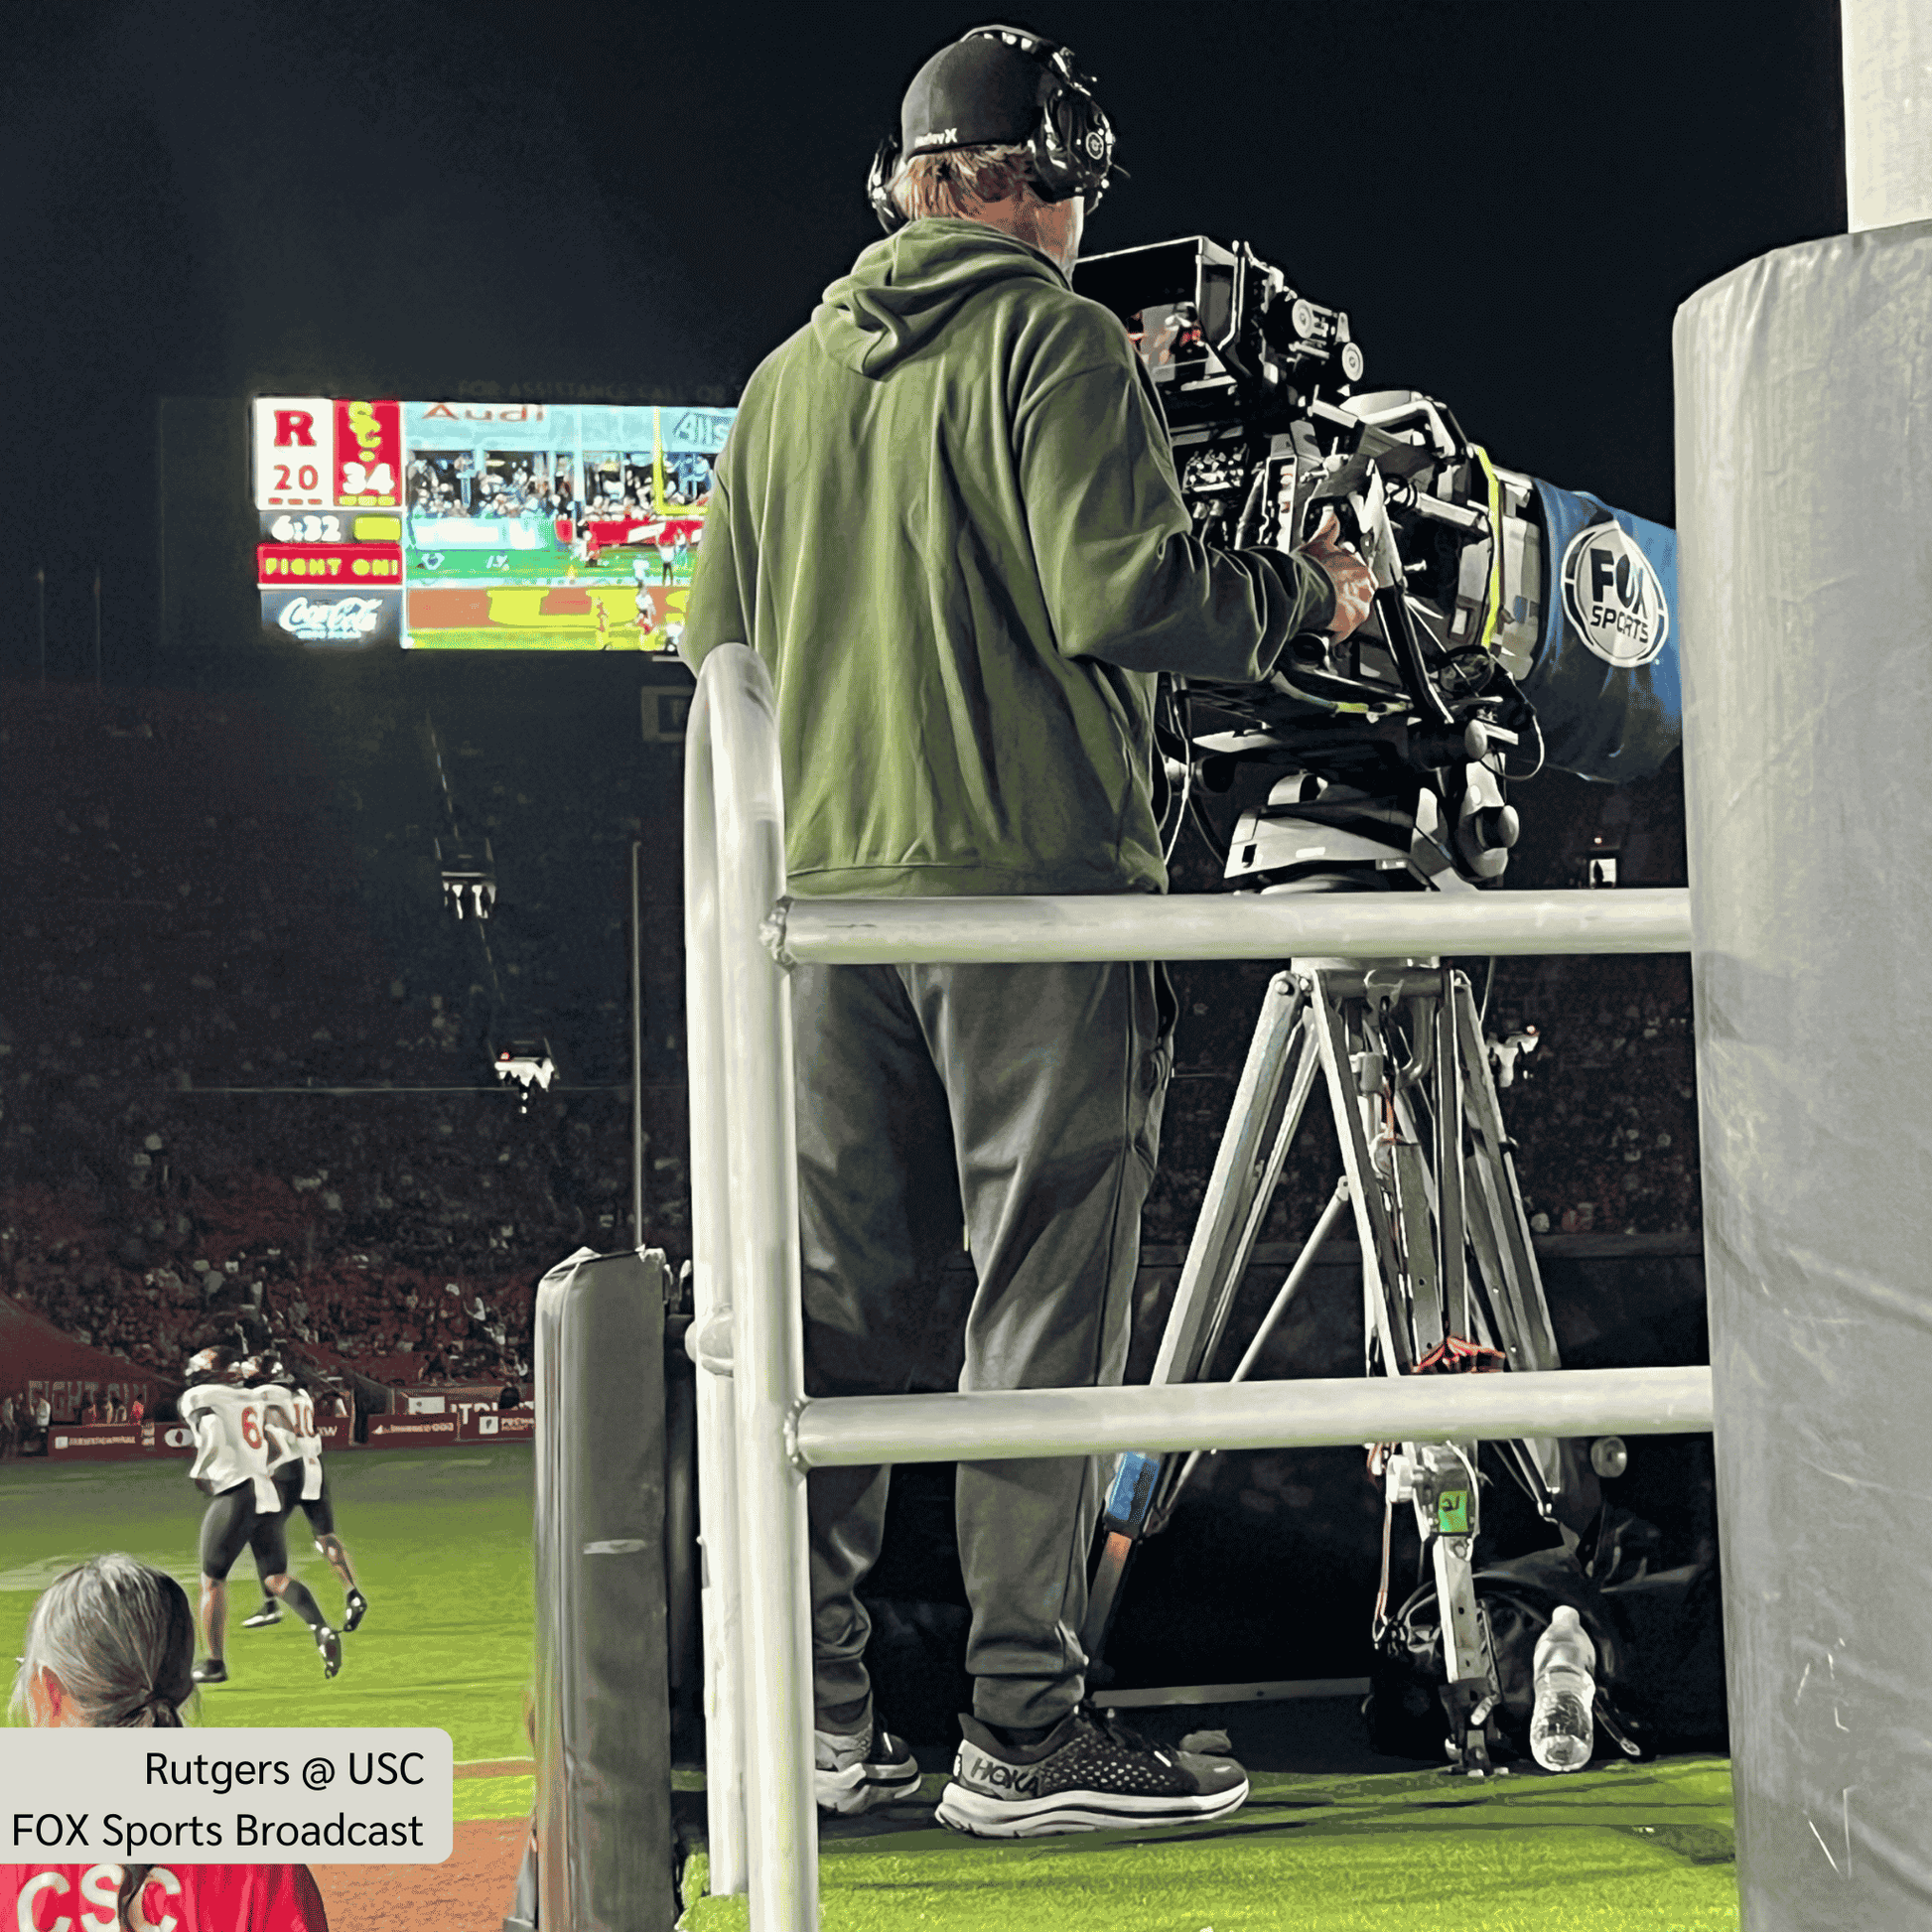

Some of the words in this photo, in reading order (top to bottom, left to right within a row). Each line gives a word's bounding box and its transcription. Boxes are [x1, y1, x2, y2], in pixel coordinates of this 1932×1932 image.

[273, 409, 317, 447] R
[273, 465, 319, 490] 20
[342, 462, 395, 495] 34
[1589, 605, 1649, 644] SPORTS
[241, 1406, 262, 1449] 6
[17, 1863, 182, 1932] CSC
